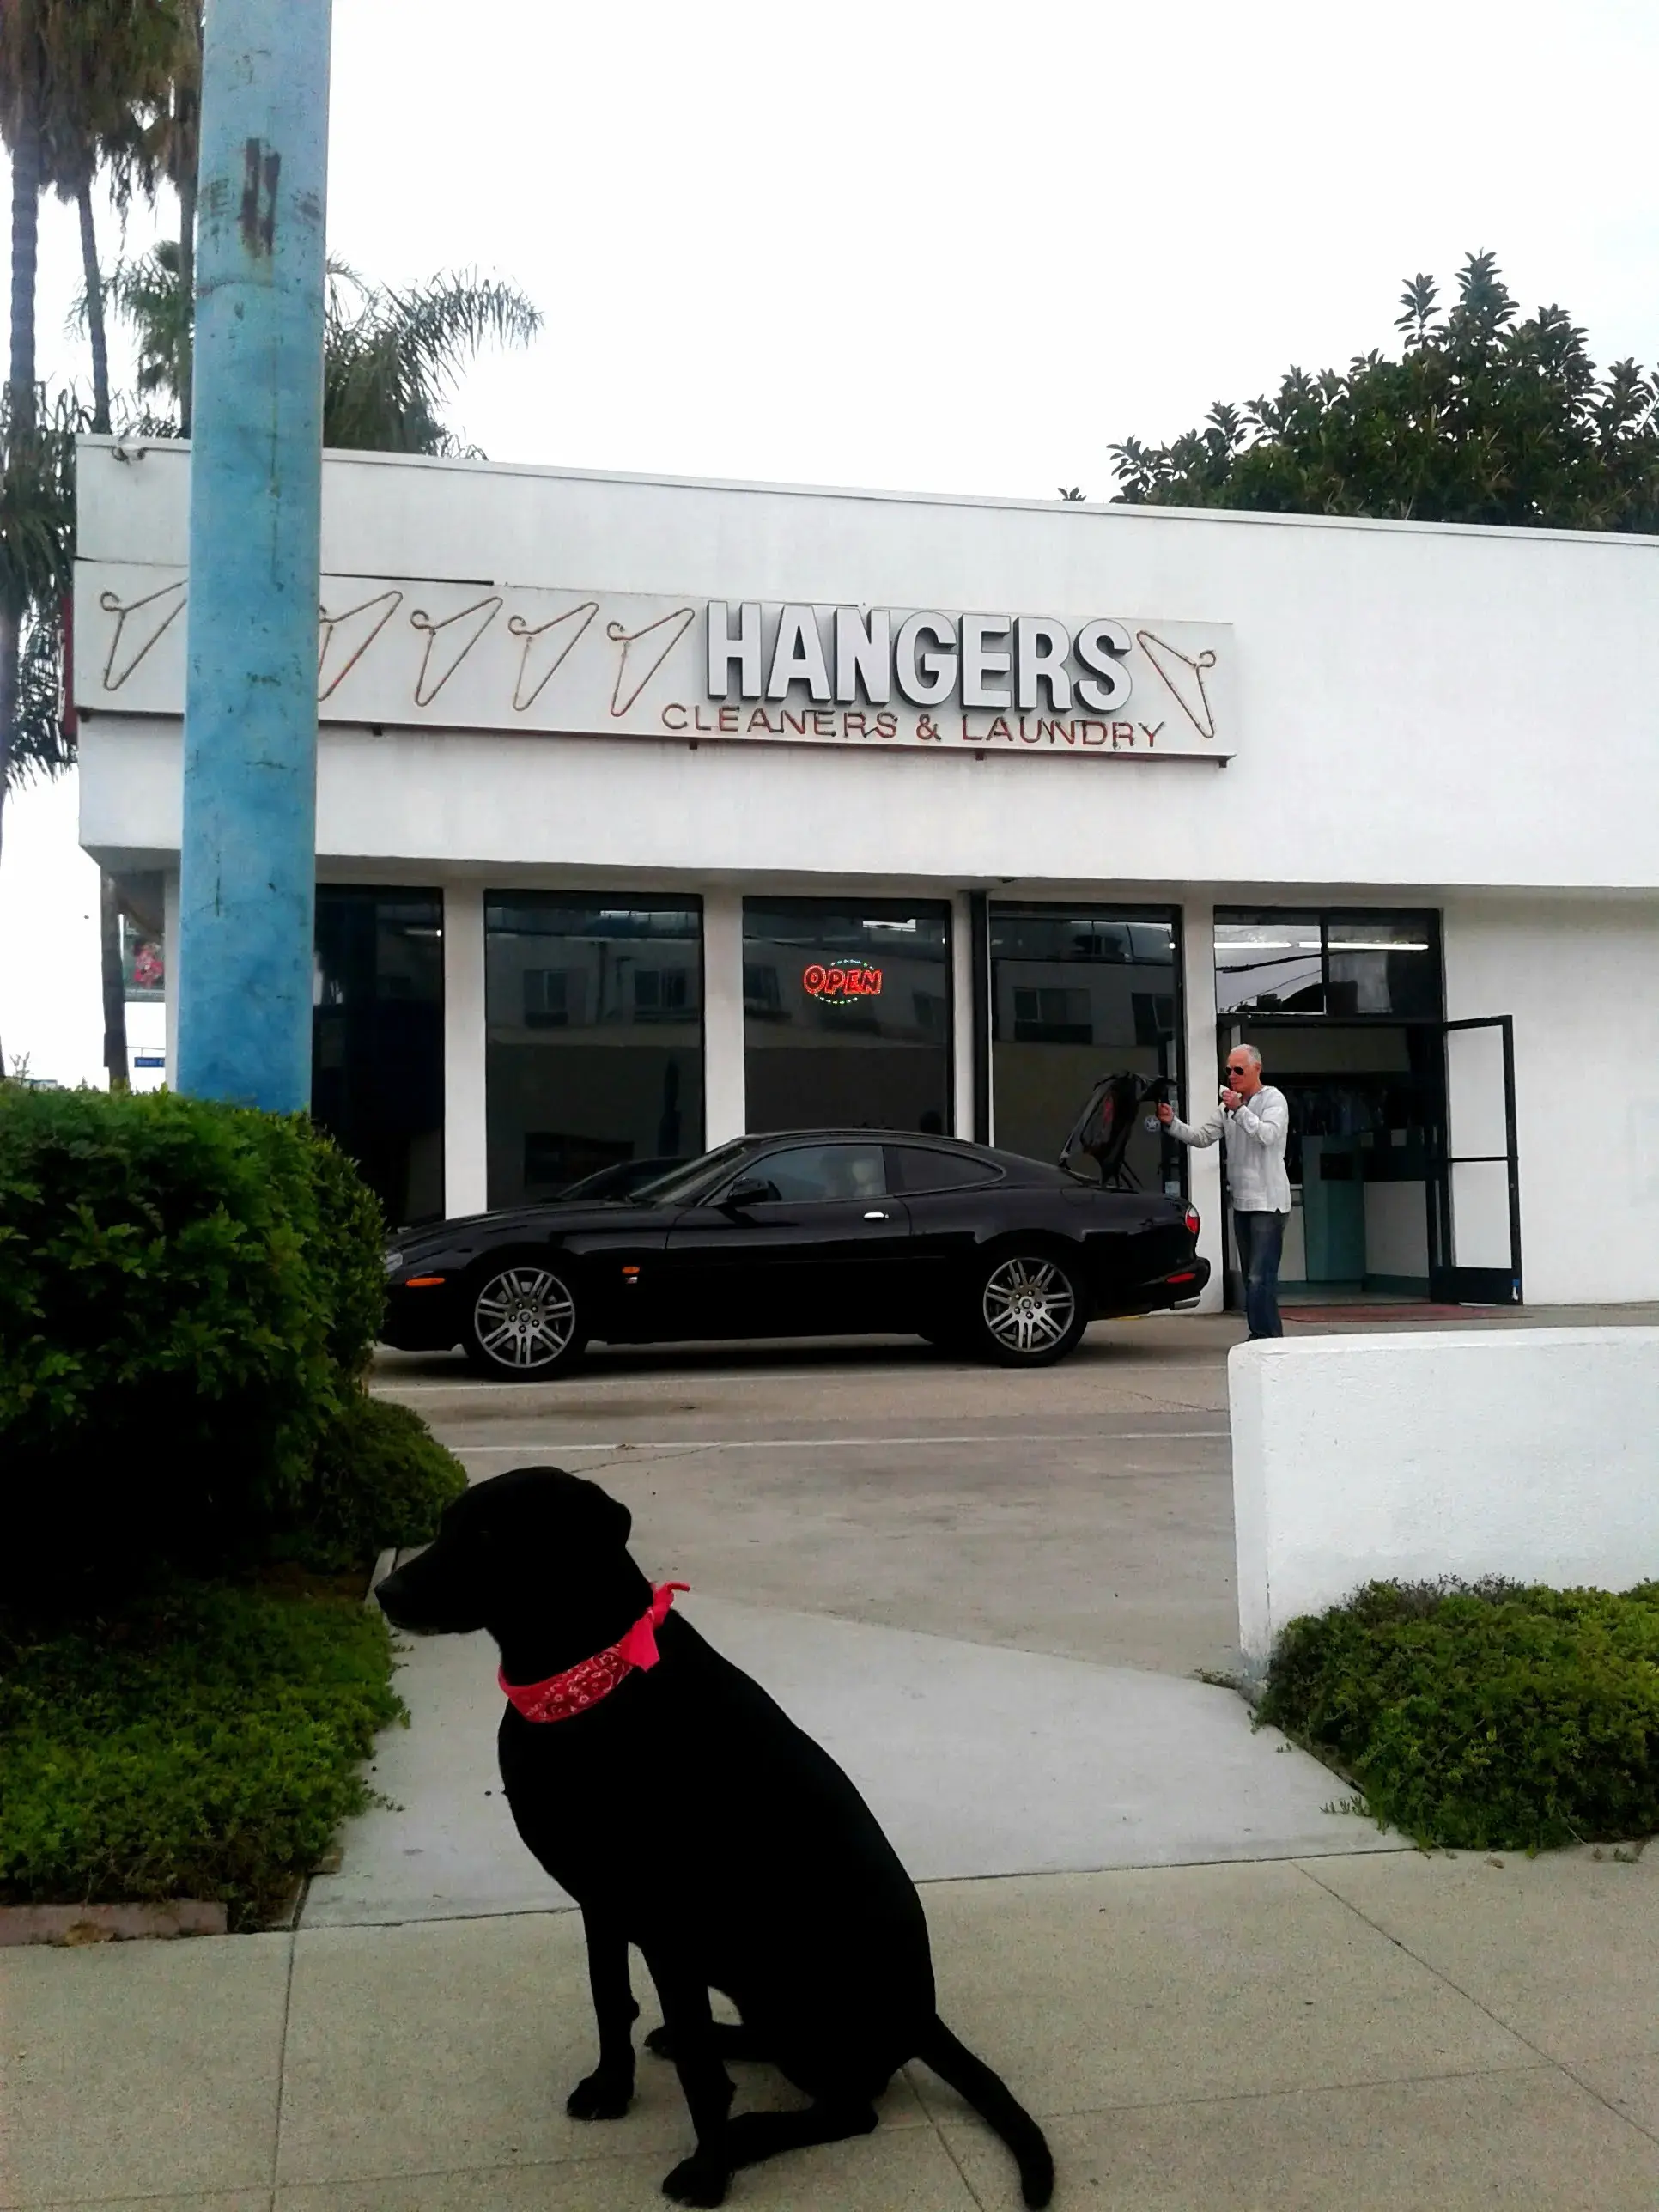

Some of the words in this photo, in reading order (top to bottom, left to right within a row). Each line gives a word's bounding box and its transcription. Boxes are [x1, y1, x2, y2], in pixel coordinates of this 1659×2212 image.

[706, 600, 1133, 714] HANGERS
[661, 702, 898, 738] CLEANERS
[915, 714, 942, 741] &
[962, 714, 1165, 748] LAUNDRY
[803, 964, 883, 995] OPEN
